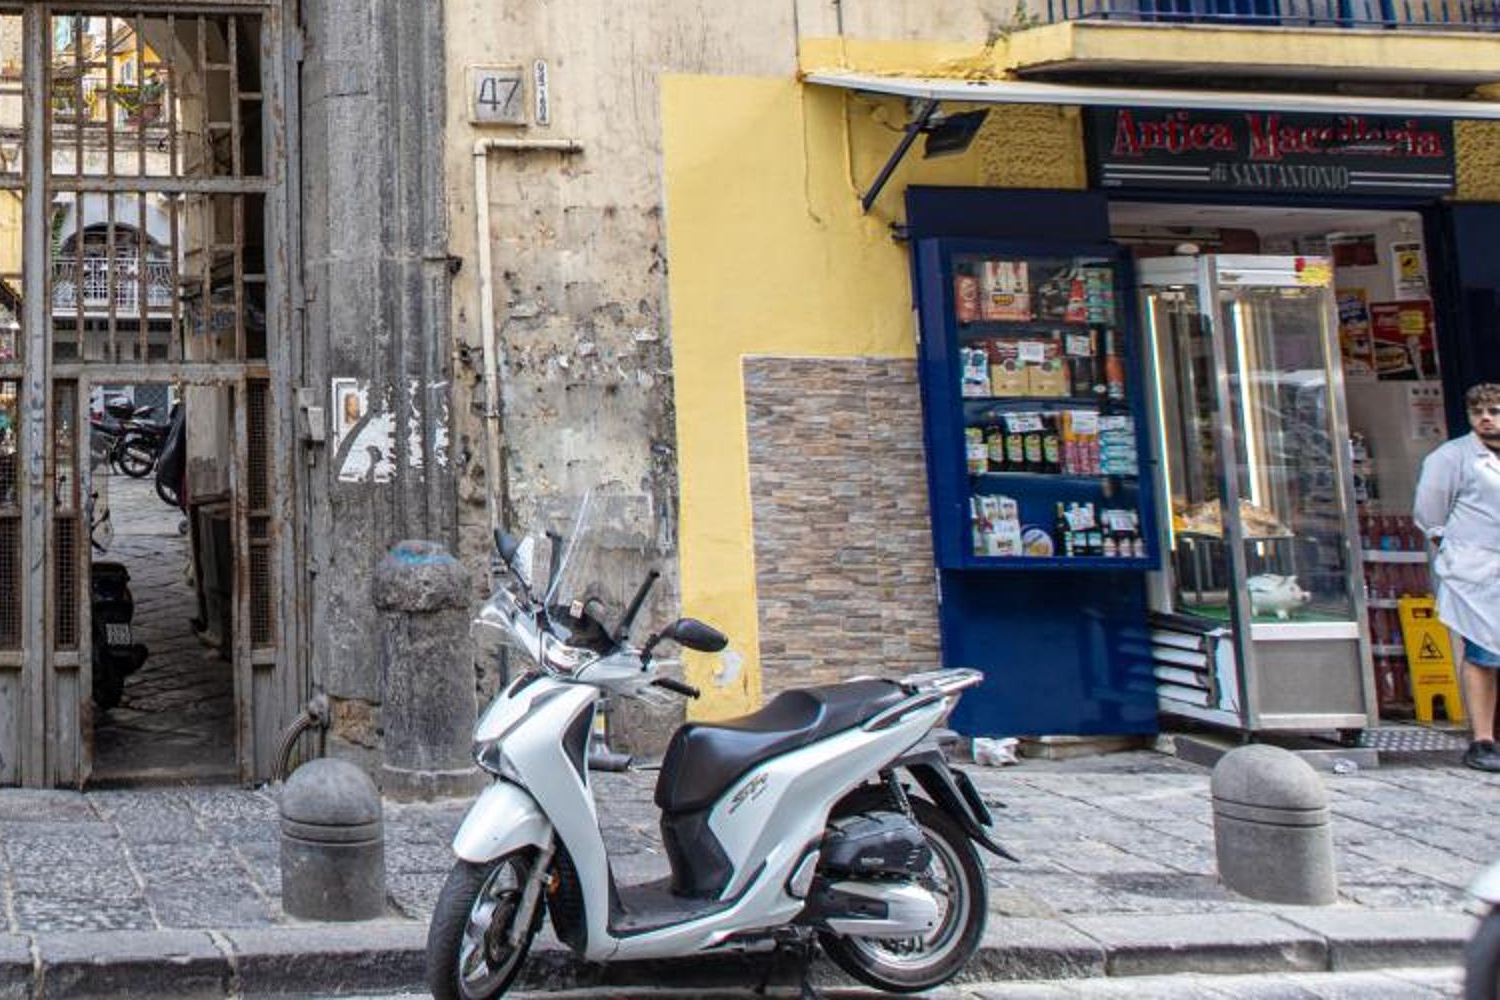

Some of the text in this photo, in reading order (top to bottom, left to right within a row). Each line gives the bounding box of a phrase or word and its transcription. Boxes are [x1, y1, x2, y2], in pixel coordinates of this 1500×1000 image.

[479, 77, 520, 114] 47
[1113, 108, 1237, 156] Antica
[1231, 163, 1349, 190] SANT'ANTONIO
